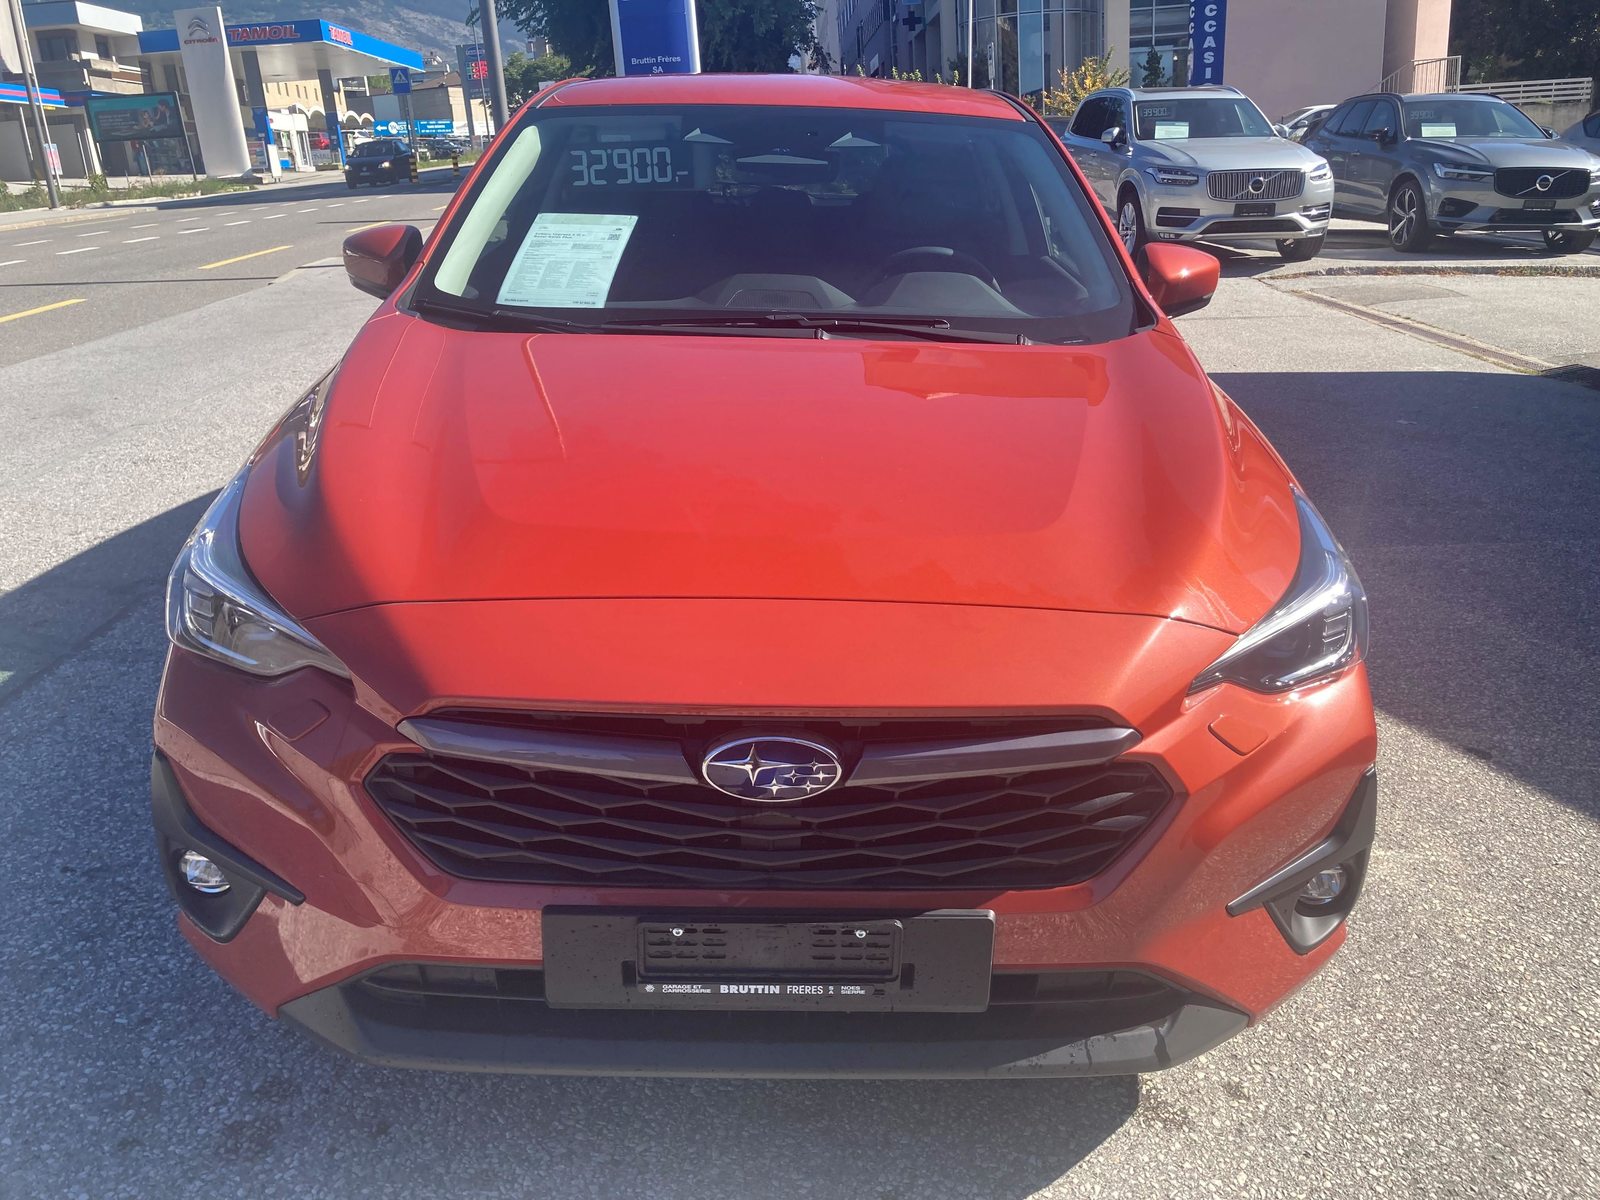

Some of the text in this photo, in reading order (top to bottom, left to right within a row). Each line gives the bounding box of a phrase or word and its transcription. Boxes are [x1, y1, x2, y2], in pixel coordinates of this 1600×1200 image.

[228, 24, 299, 42] TAMOIL
[328, 25, 353, 45] TAMOIL
[1202, 4, 1218, 85] CCASI
[631, 55, 681, 65] Bruttin Frères
[720, 984, 780, 994] BRUTTIN
